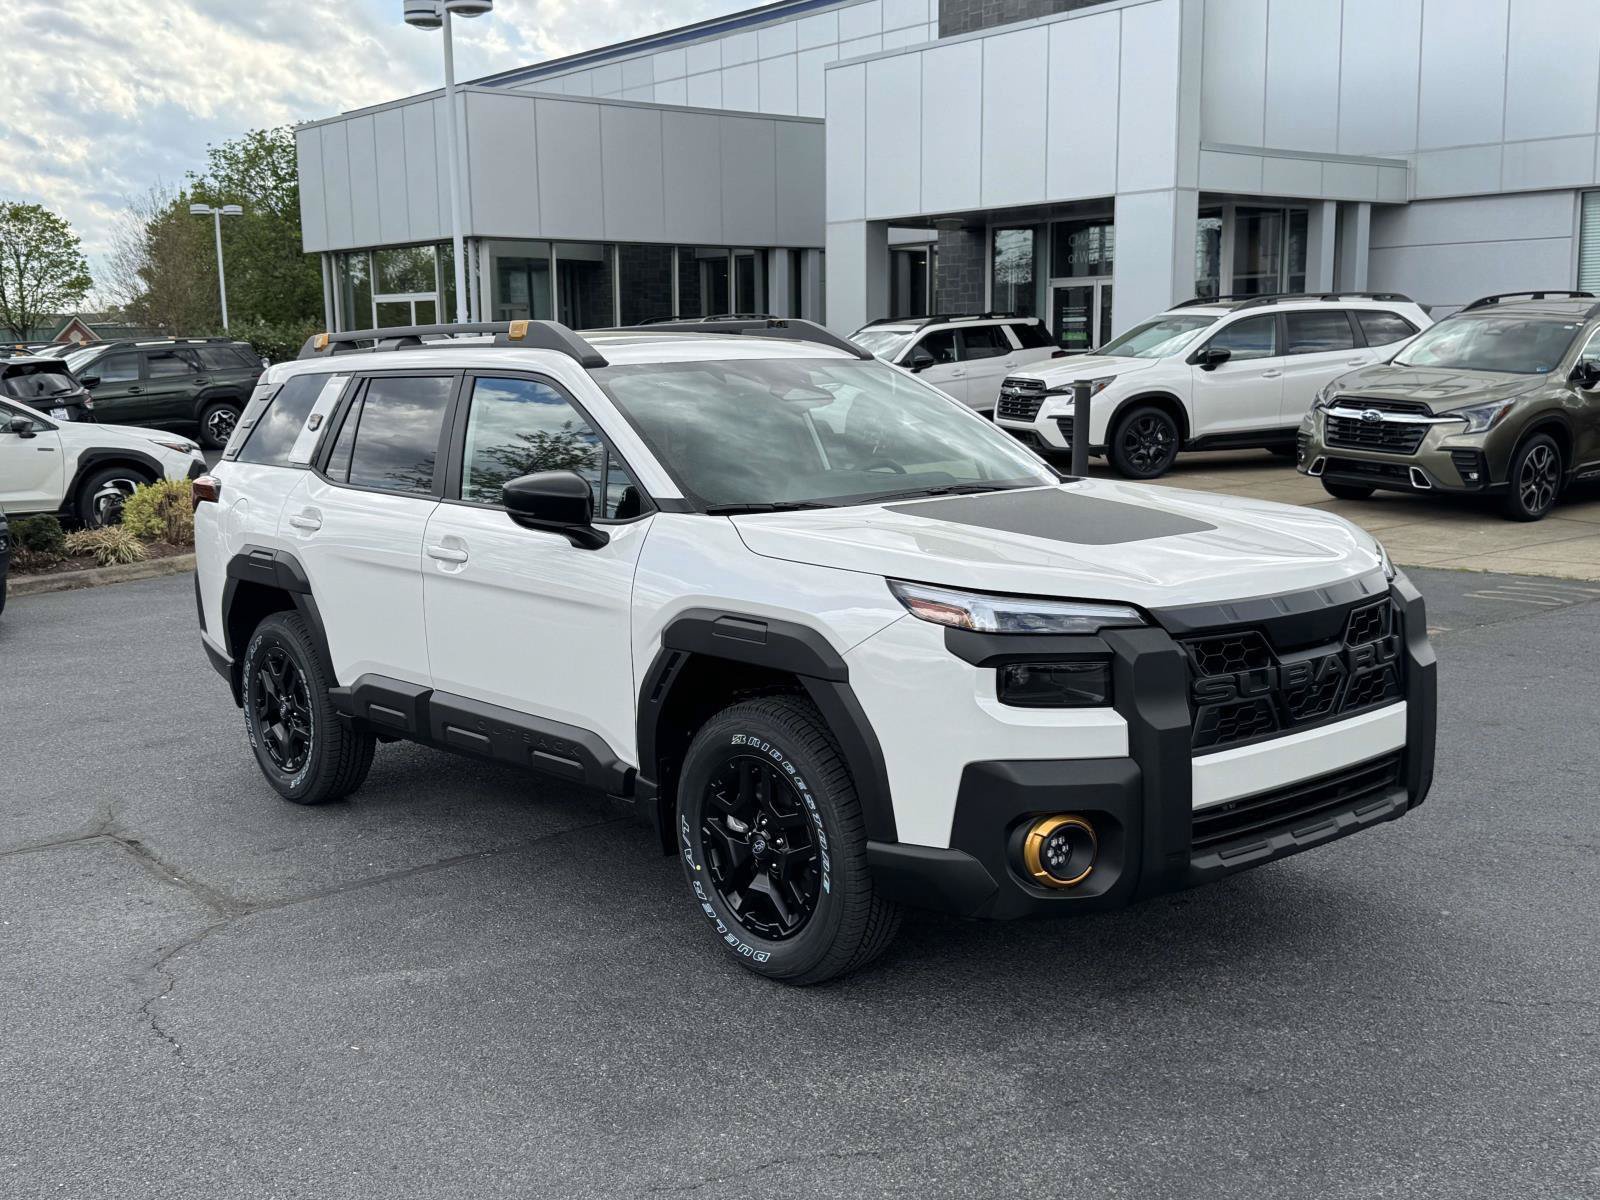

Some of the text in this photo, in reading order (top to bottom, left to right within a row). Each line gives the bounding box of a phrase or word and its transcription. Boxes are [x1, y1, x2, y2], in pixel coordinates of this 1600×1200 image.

[1194, 635, 1400, 702] SUBARU
[681, 814, 771, 963] DUELER A/T
[731, 734, 830, 894] BRIDGESTONE
